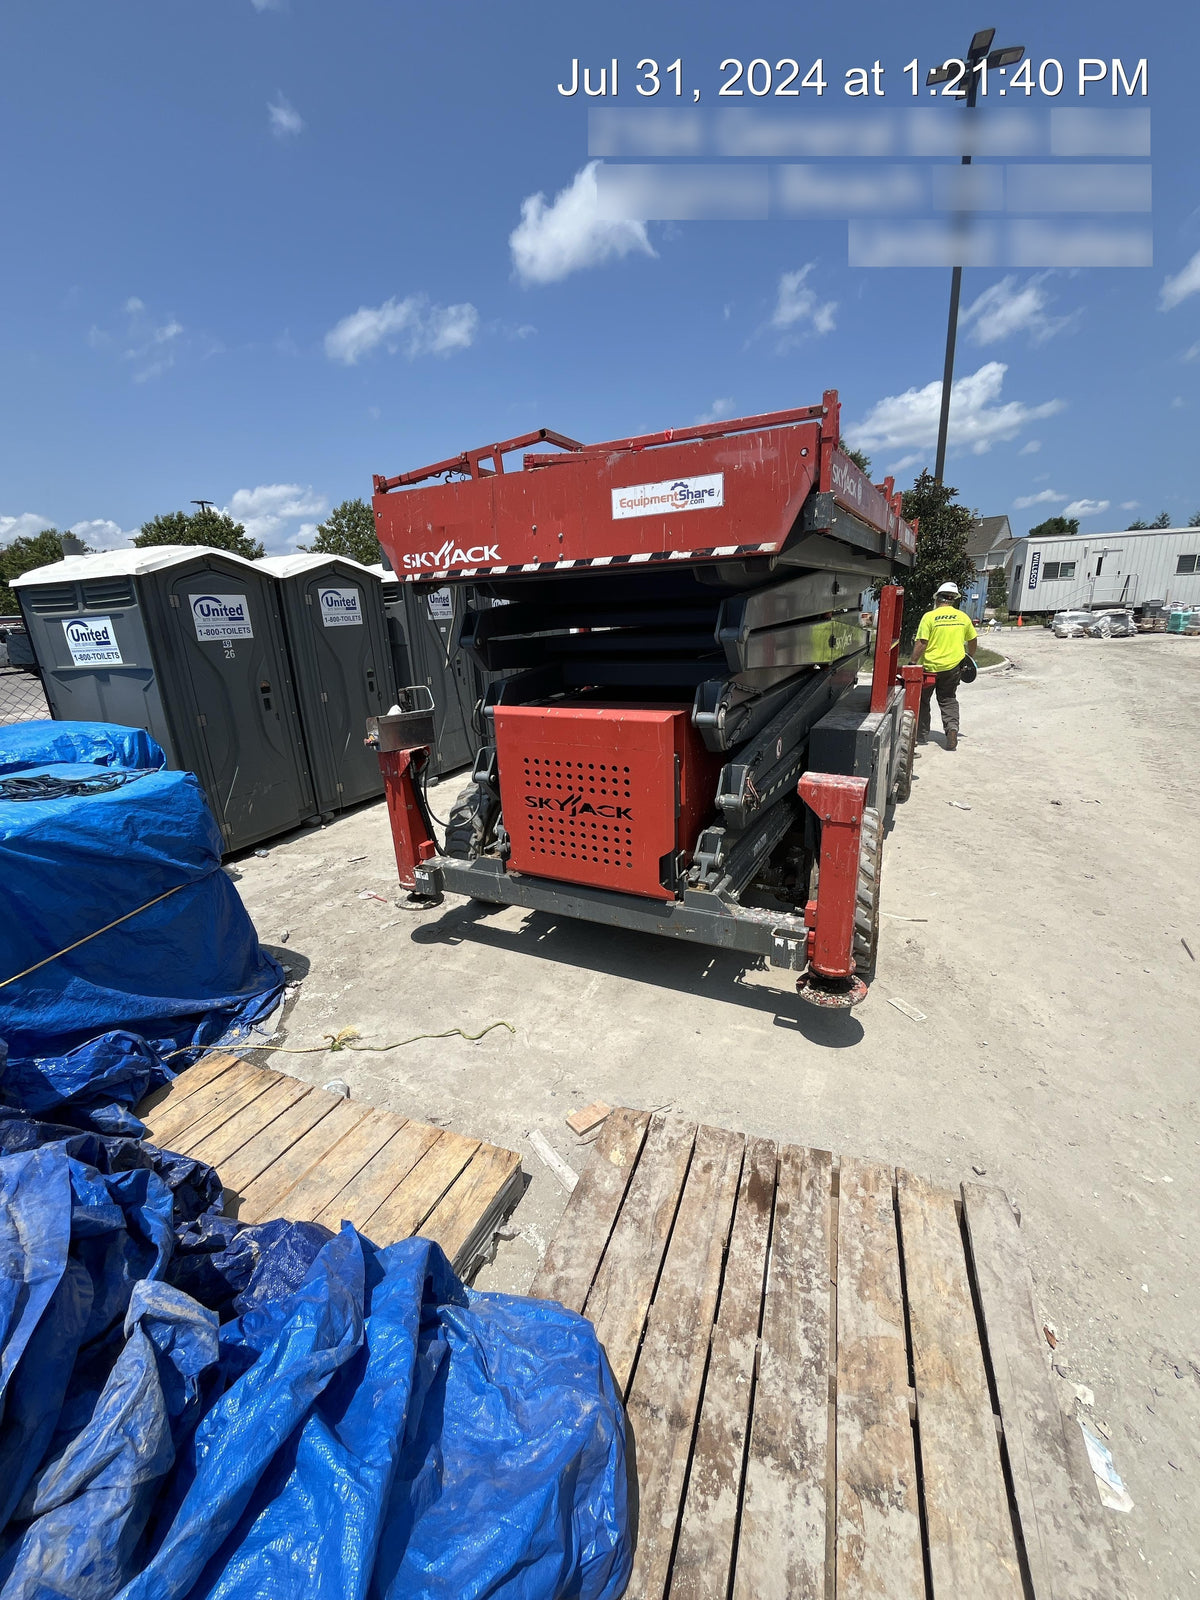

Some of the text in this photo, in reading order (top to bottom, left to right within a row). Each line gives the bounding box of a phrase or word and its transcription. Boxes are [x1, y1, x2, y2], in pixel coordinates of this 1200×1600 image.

[619, 487, 715, 509] EquipmentShare
[402, 540, 502, 569] SKYJACK
[1030, 553, 1040, 588] WILLSCOT
[325, 596, 356, 607] United
[200, 603, 244, 617] United
[324, 615, 362, 623] 1-800-TOILETS
[70, 626, 110, 642] United
[199, 627, 251, 636] 1-800-TOILETS
[74, 651, 120, 661] 1-800-TOILETS
[224, 649, 236, 659] 26
[524, 793, 634, 821] SKYJACK
